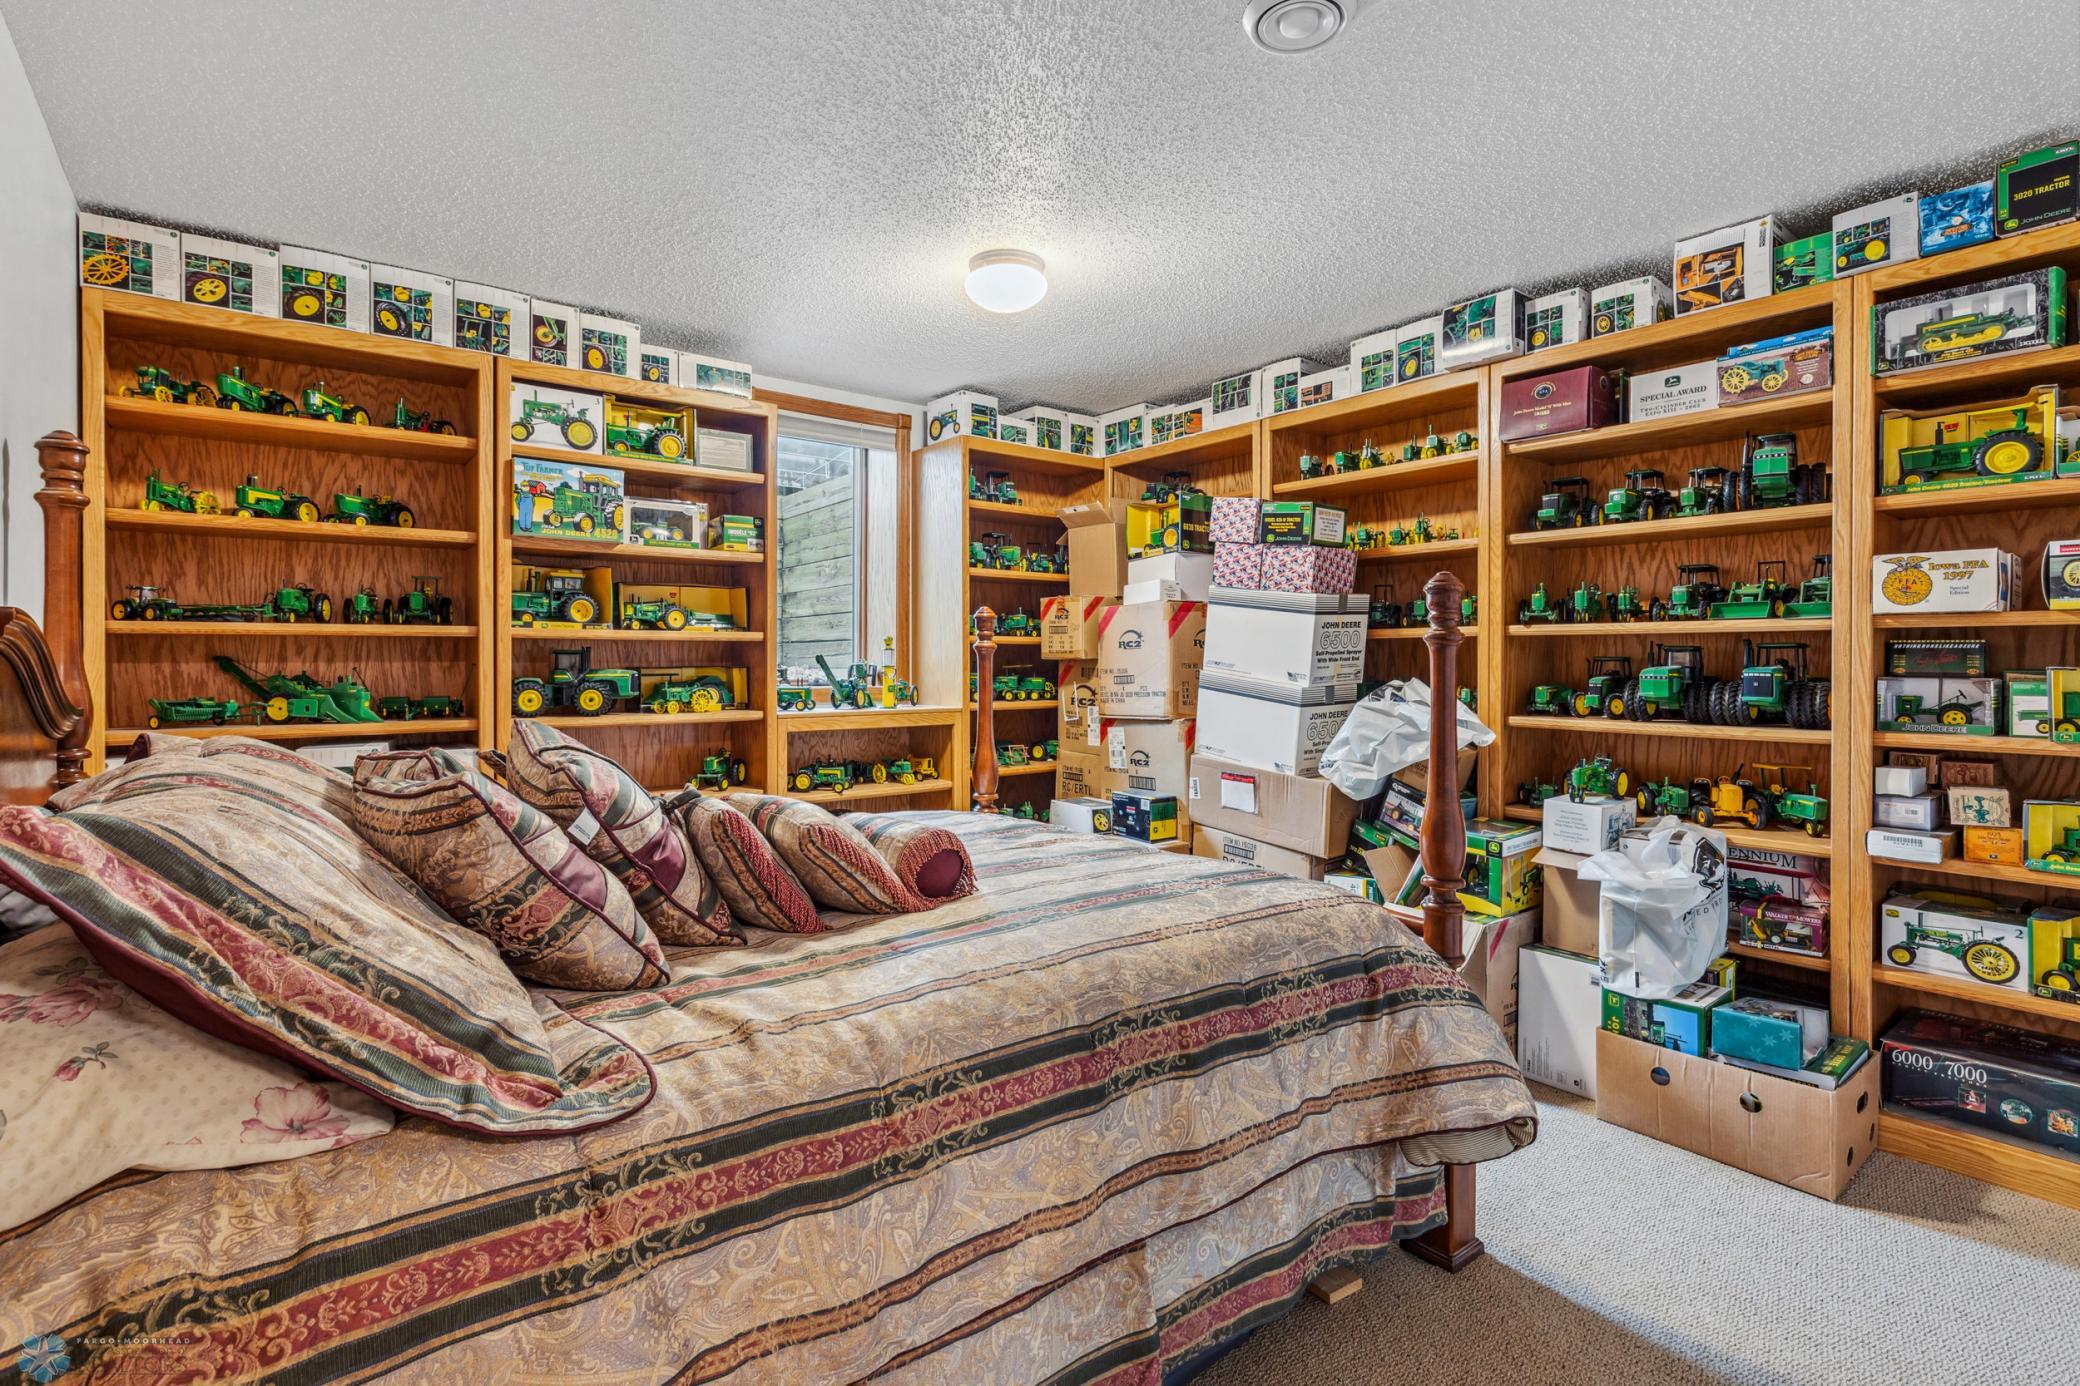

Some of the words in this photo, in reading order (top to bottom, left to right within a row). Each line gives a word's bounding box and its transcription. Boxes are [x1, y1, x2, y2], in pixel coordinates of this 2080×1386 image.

[2013, 190, 2033, 201] 3020
[2034, 180, 2070, 196] TRACTOR
[2021, 214, 2043, 225] JOHN
[2043, 207, 2072, 219] DEERE
[1639, 391, 1675, 403] SPECIAL
[1676, 385, 1707, 397] AWARD
[535, 464, 564, 475] FARMER
[1962, 559, 1990, 569] FFA
[1942, 570, 1975, 581] 1997
[1321, 621, 1340, 630] JOHN
[1340, 621, 1362, 629] DEERE
[1118, 640, 1142, 650] RC2
[1320, 630, 1361, 650] 6500
[1309, 711, 1328, 721] JOHN
[1328, 709, 1348, 719] DEERE
[1306, 720, 1347, 742] 650
[1129, 758, 1150, 767] RC2
[1062, 781, 1093, 796] RC/ERTL
[1728, 847, 1798, 869] ENNIUM
[1764, 911, 1789, 920] WALKER
[2015, 929, 2024, 939] 2
[1891, 1049, 1934, 1071] 6000
[1944, 1061, 1988, 1084] 7000
